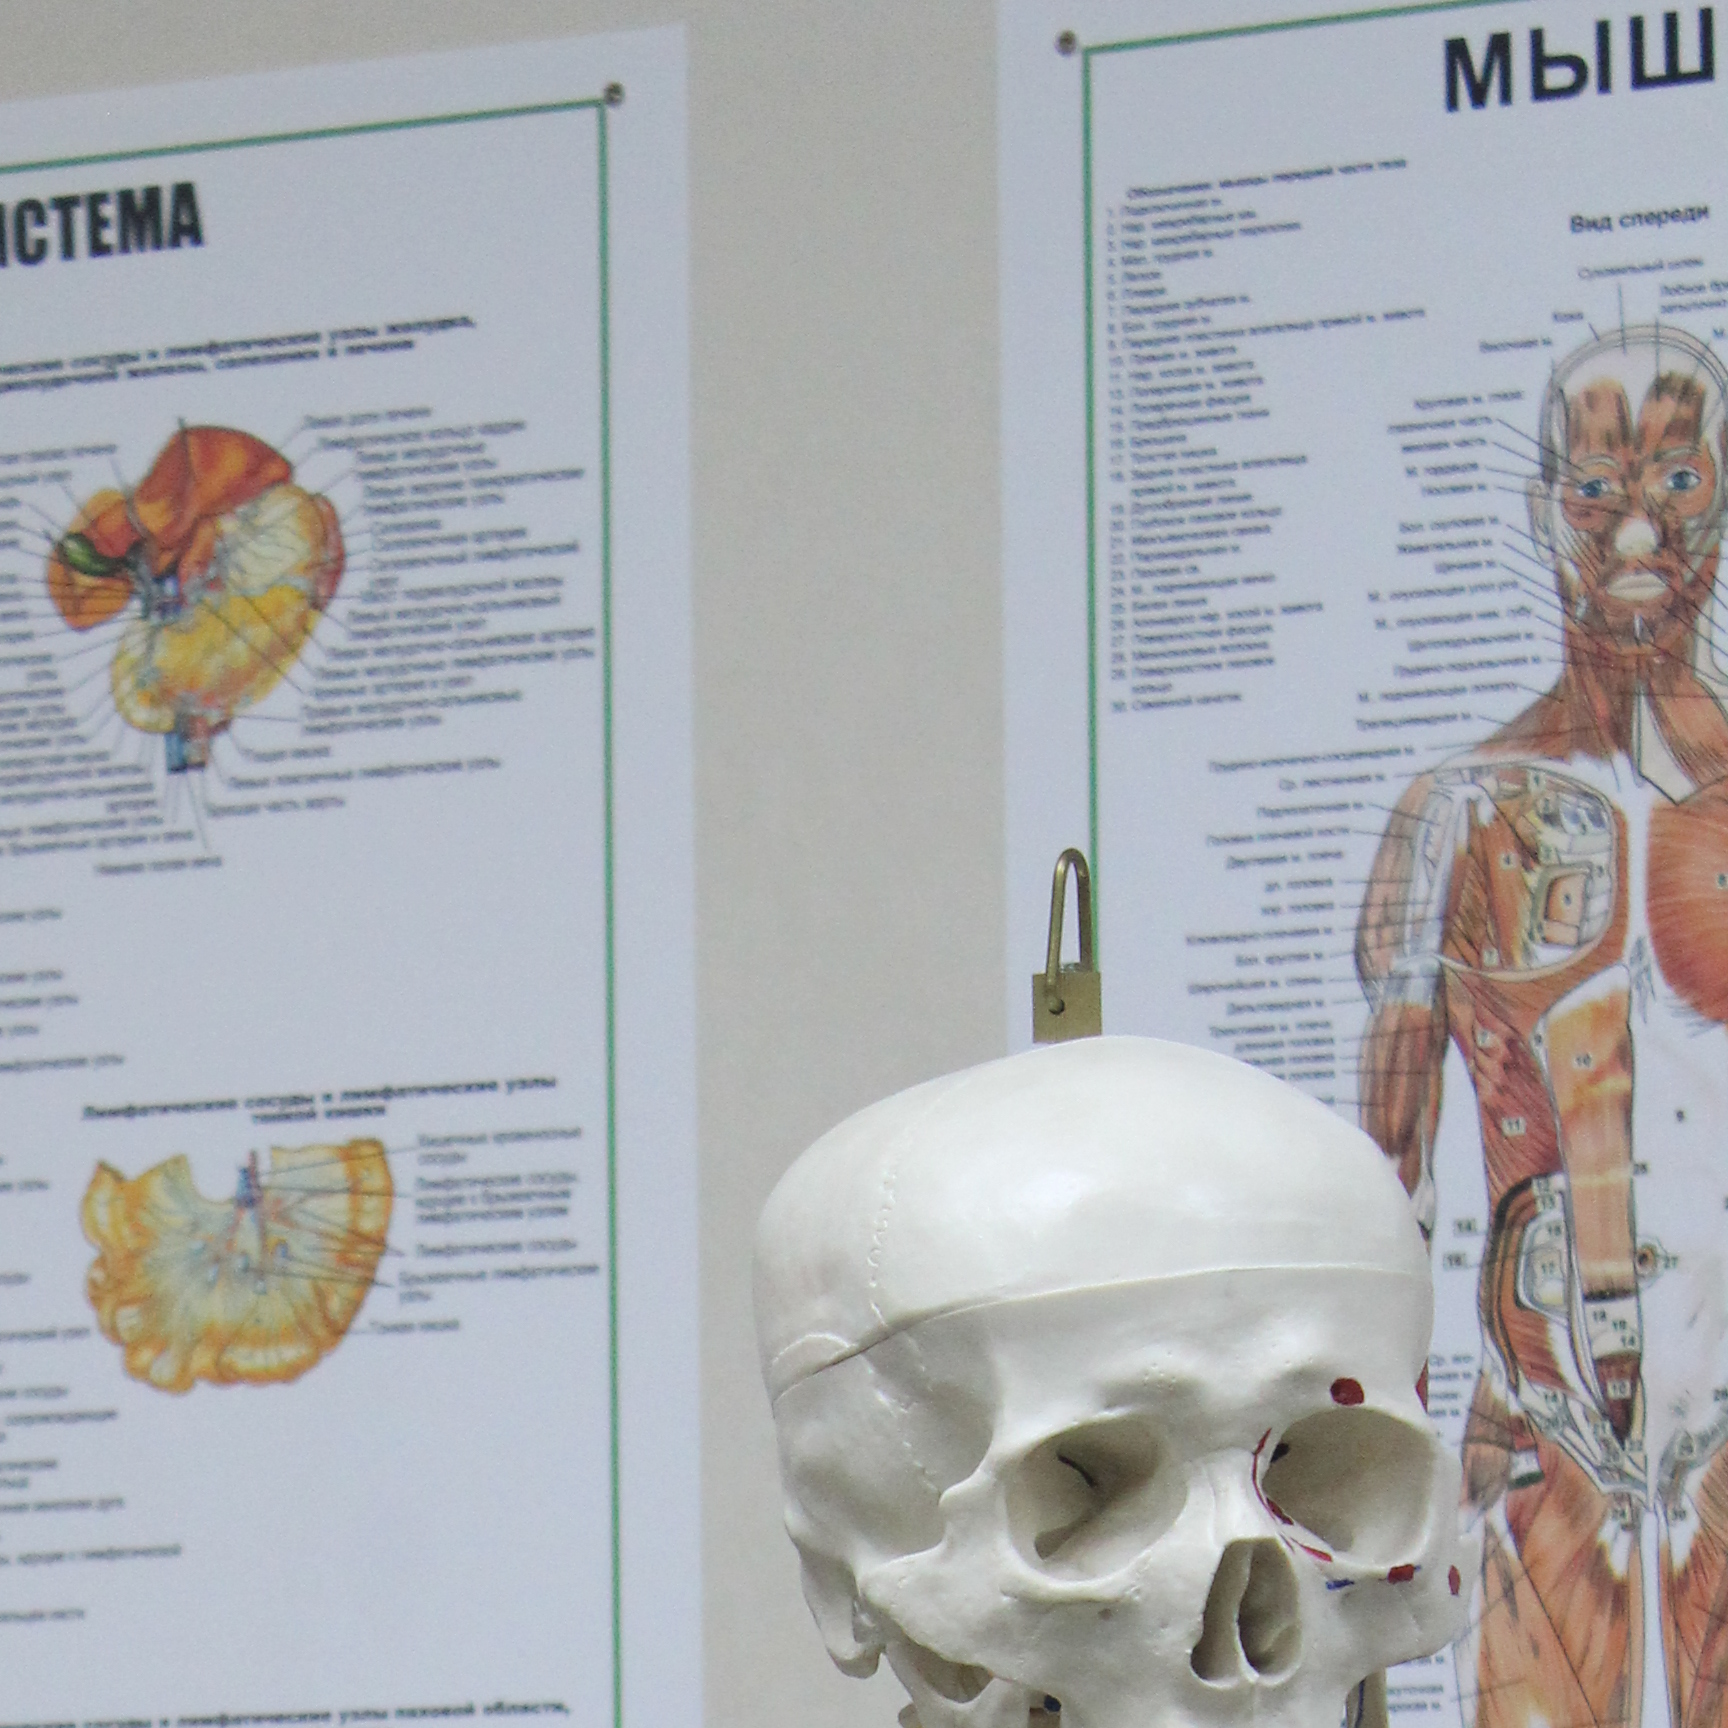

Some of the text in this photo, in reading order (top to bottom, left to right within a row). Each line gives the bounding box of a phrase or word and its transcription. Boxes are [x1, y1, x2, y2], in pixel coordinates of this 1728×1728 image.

[1443, 7, 1715, 114] МЫШ
[1568, 204, 1711, 234] Вид спереди
